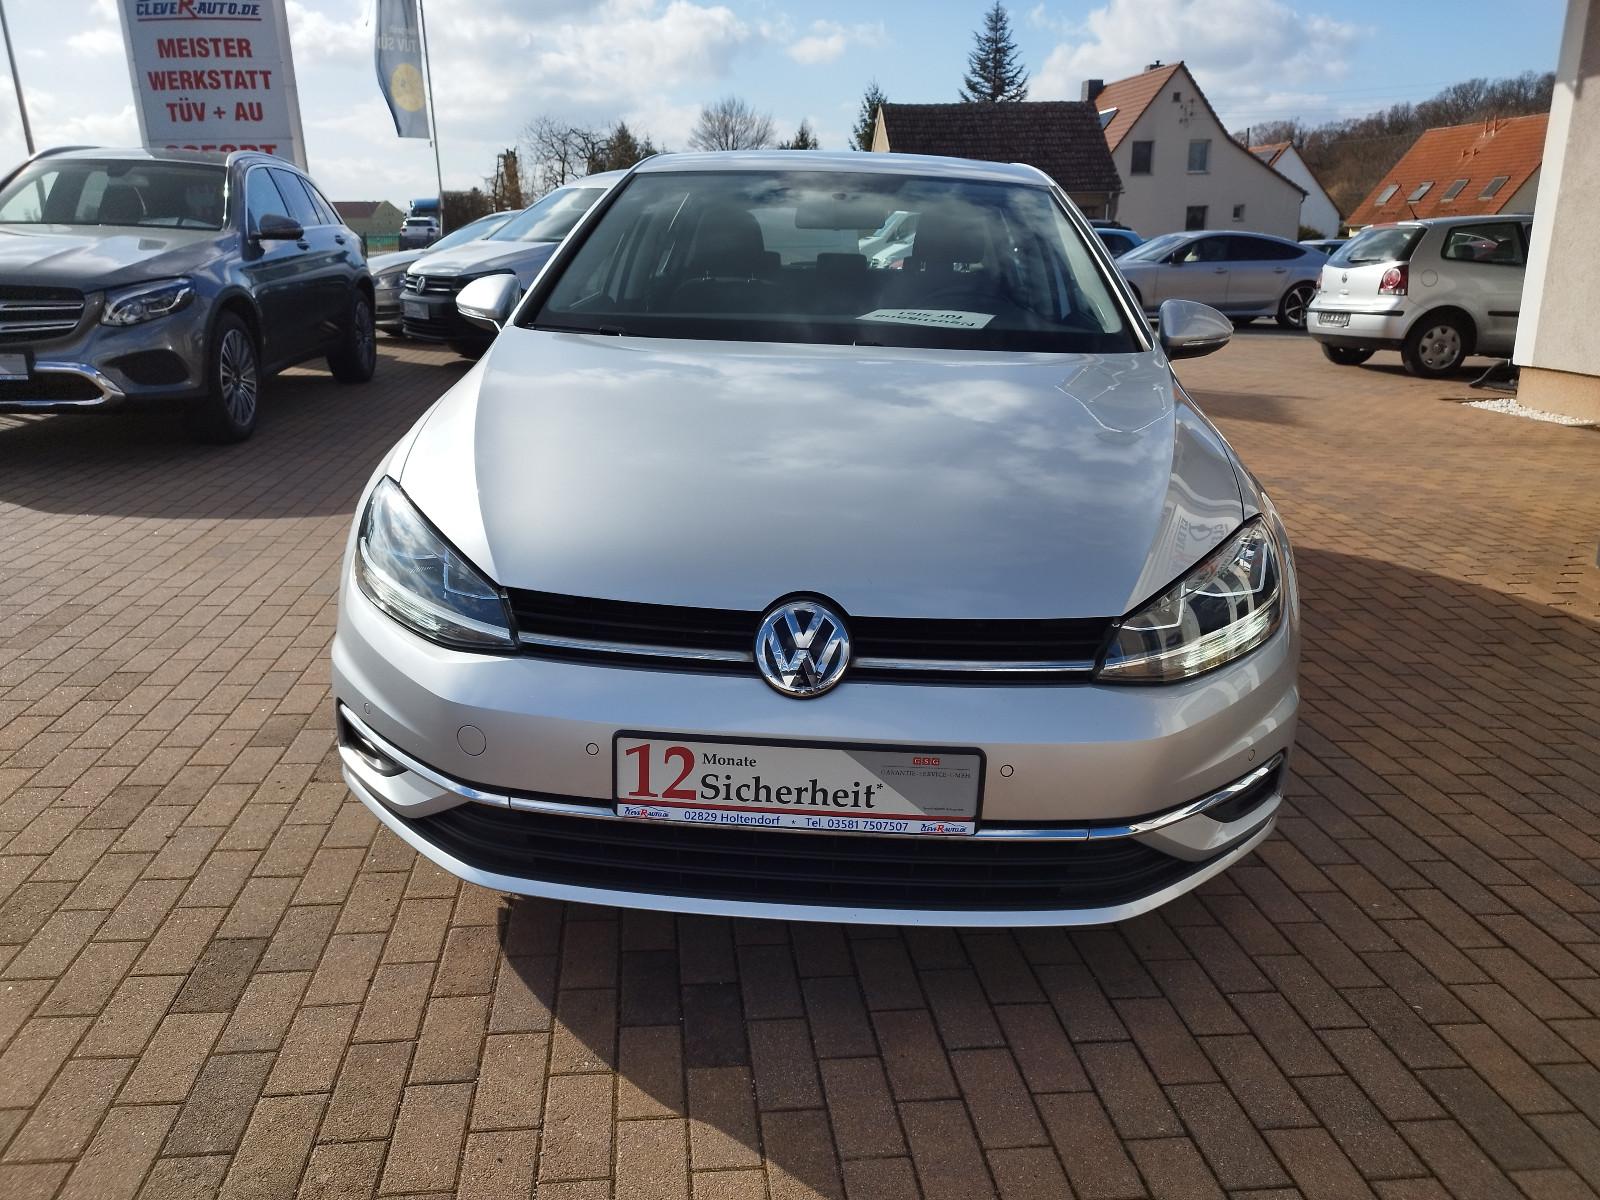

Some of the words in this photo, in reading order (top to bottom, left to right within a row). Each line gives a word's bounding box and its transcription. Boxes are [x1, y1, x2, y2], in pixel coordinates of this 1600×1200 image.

[157, 37, 253, 59] MEISTER
[147, 70, 272, 91] WERKSTATT
[166, 97, 206, 122] TÜV
[213, 106, 226, 119] +
[235, 102, 264, 122] AU
[702, 752, 757, 768] Monate
[625, 743, 697, 801] 12
[684, 810, 717, 822] 02829
[720, 813, 780, 826] Holtendorf
[805, 817, 825, 829] Tel.
[827, 819, 859, 831] 03581
[862, 820, 909, 832] 7507507
